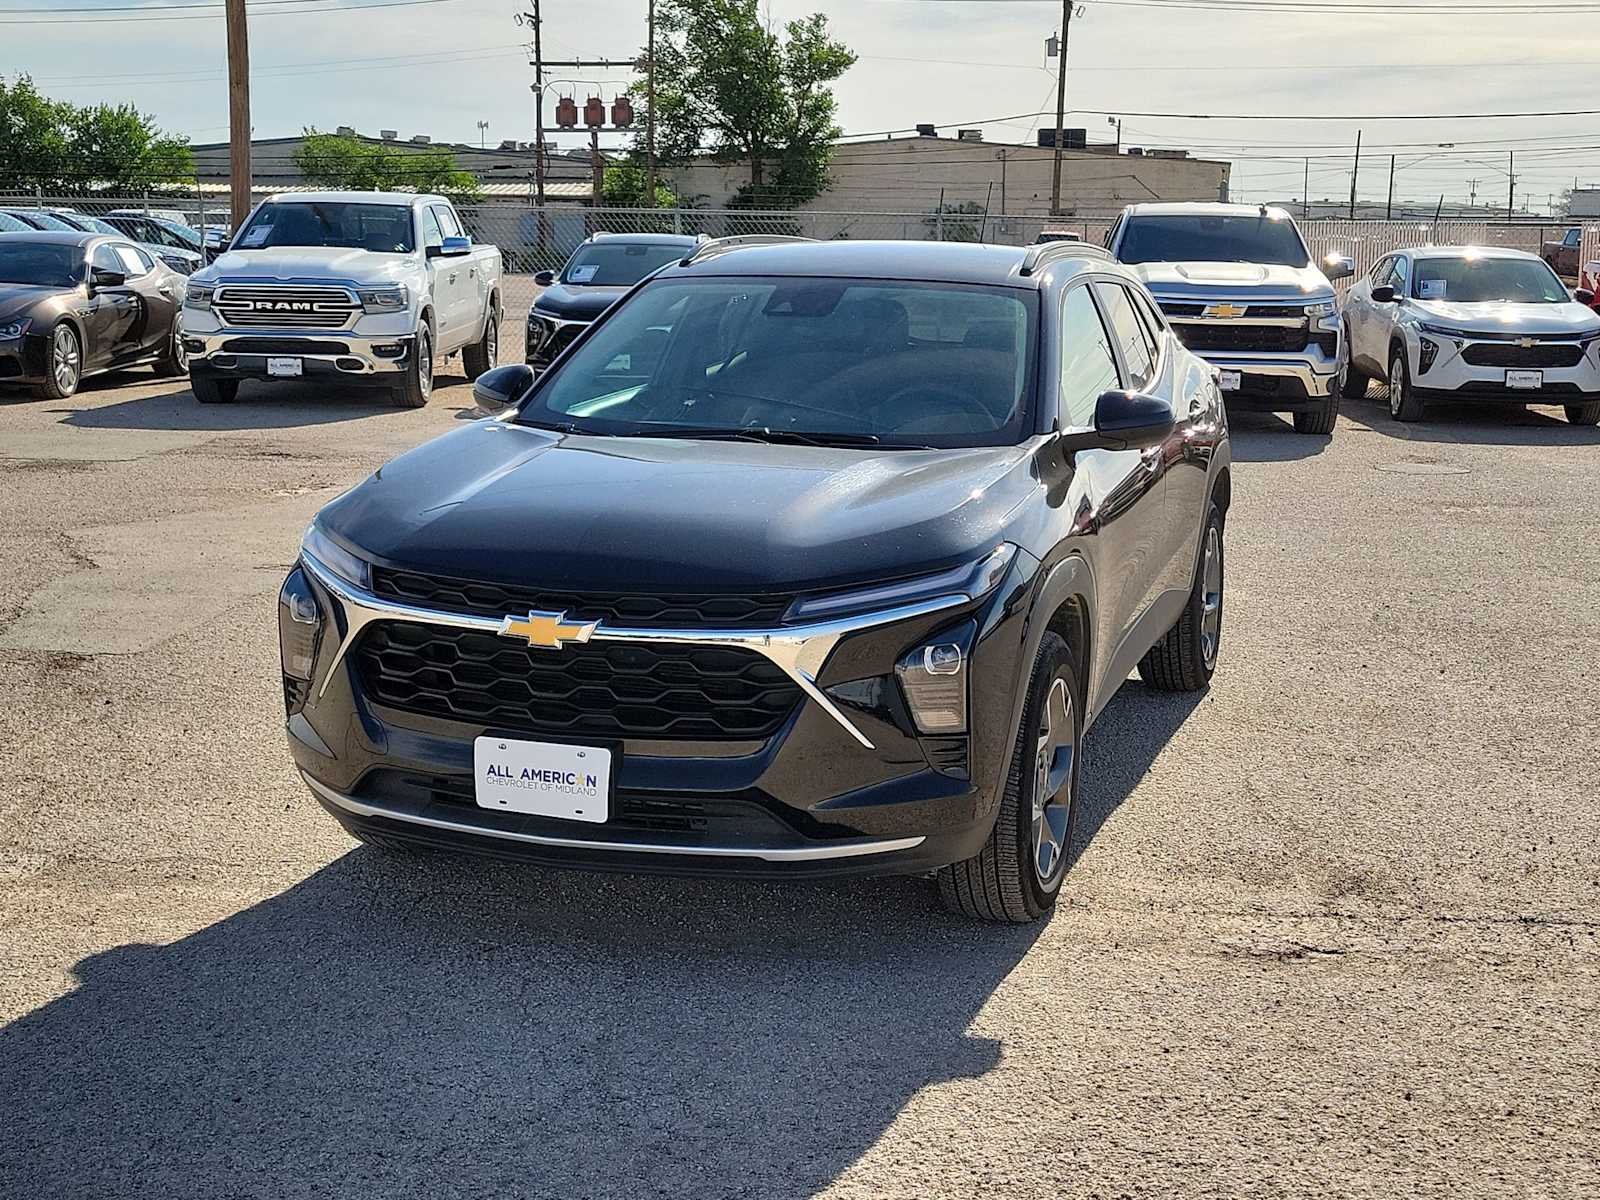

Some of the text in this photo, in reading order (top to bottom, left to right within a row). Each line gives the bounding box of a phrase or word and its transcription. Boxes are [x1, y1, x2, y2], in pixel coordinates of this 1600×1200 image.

[256, 301, 311, 310] RAM
[487, 764, 513, 778] ALL
[486, 776, 597, 796] CHEVROLET OF MIDLAND
